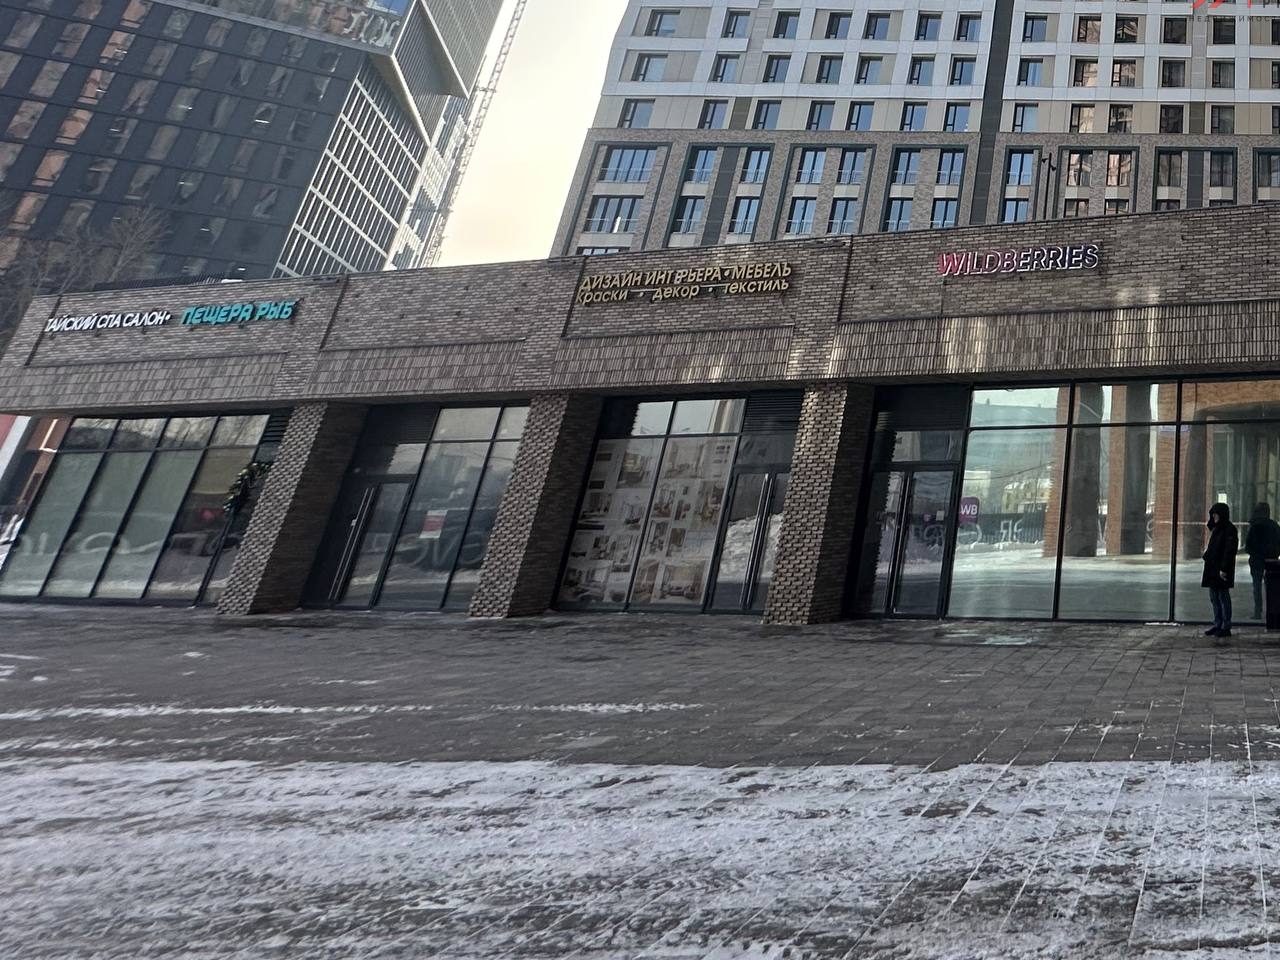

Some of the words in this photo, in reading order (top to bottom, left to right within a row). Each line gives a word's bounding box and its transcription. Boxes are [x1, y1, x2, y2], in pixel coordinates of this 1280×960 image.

[938, 244, 1099, 276] WILDBERRIES
[580, 269, 643, 291] ДИЗАЙН
[644, 268, 722, 286] ИНТЕРЬЕРА
[731, 262, 792, 280] МЕБЕЛЬ
[44, 313, 98, 332] ТАЙСКИЙ
[97, 314, 122, 329] СПА
[122, 311, 166, 327] САЛОН
[182, 303, 253, 325] ПЕЩЕРА
[254, 299, 297, 320] РЫБ
[960, 504, 978, 515] WB
